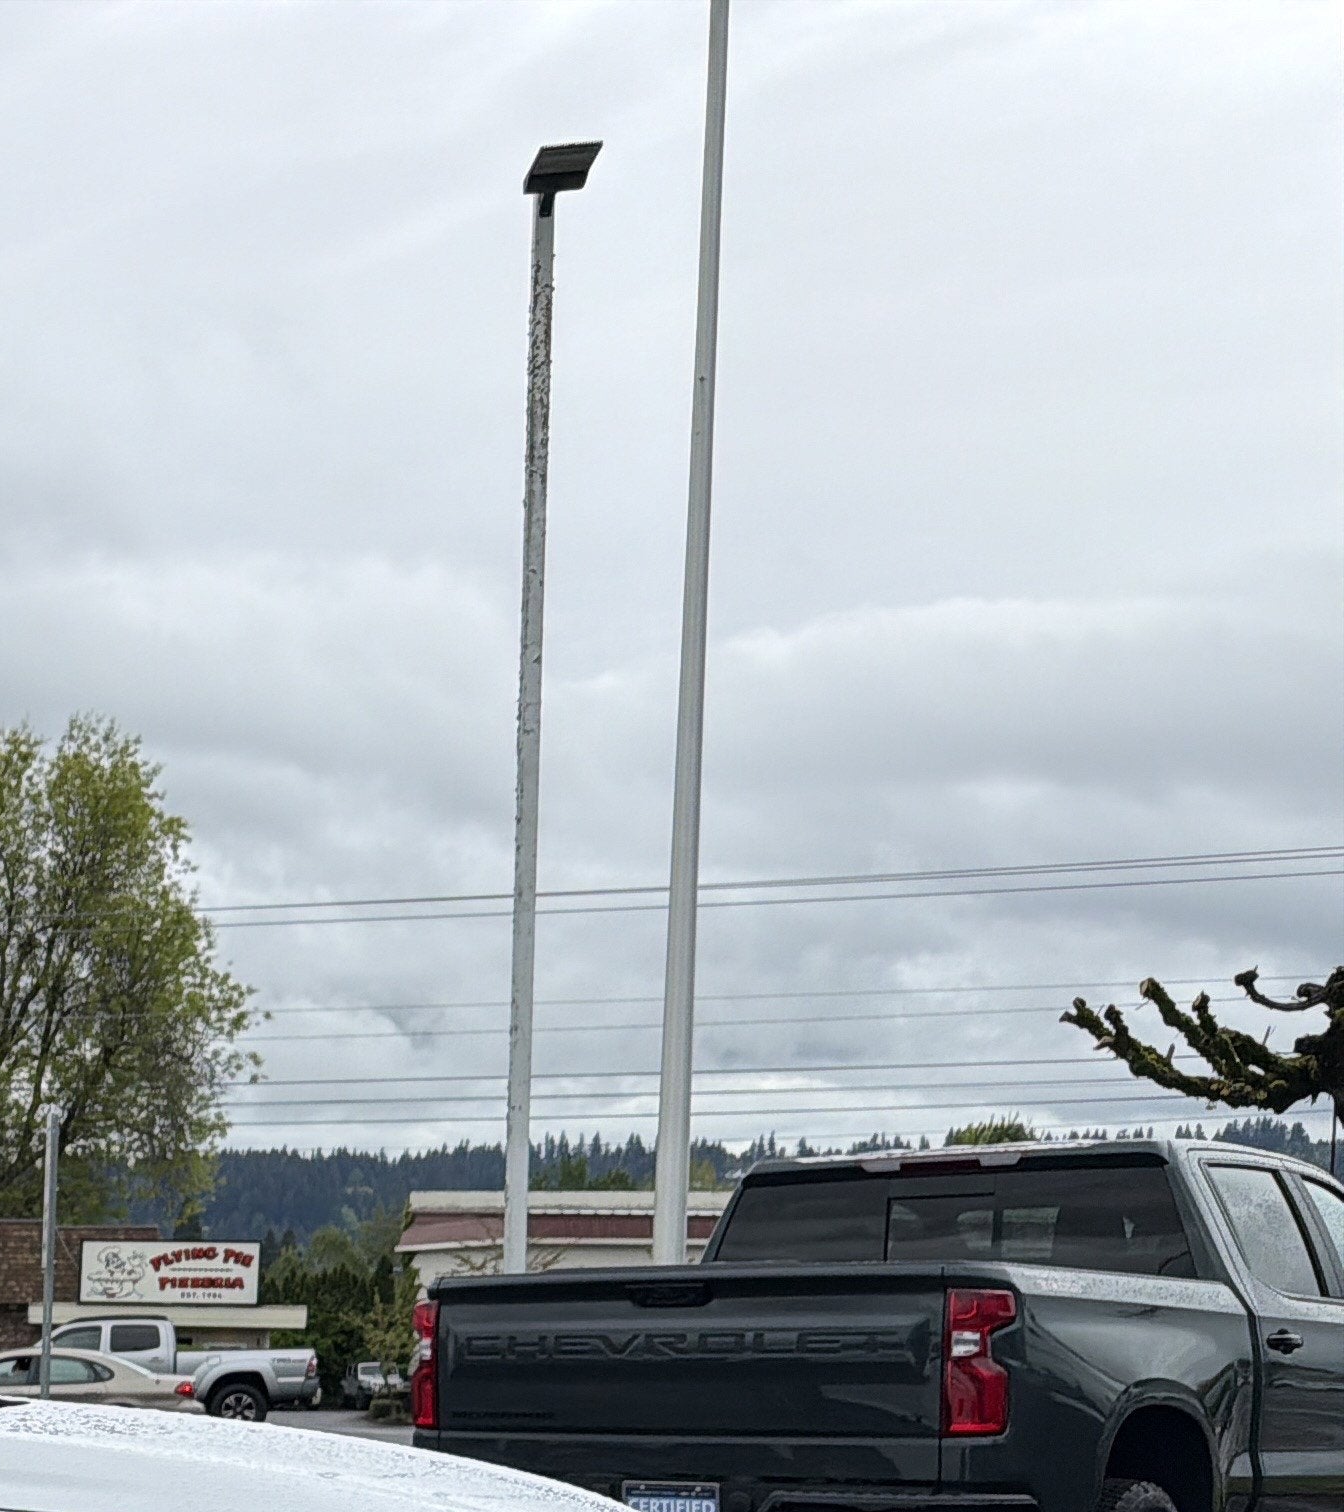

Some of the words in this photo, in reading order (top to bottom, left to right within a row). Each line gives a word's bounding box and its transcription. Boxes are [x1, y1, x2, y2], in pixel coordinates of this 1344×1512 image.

[149, 1247, 219, 1272] FLYING
[223, 1248, 255, 1268] PIE
[158, 1277, 245, 1292] PIZZERIA
[465, 1331, 904, 1360] CHEVROLET
